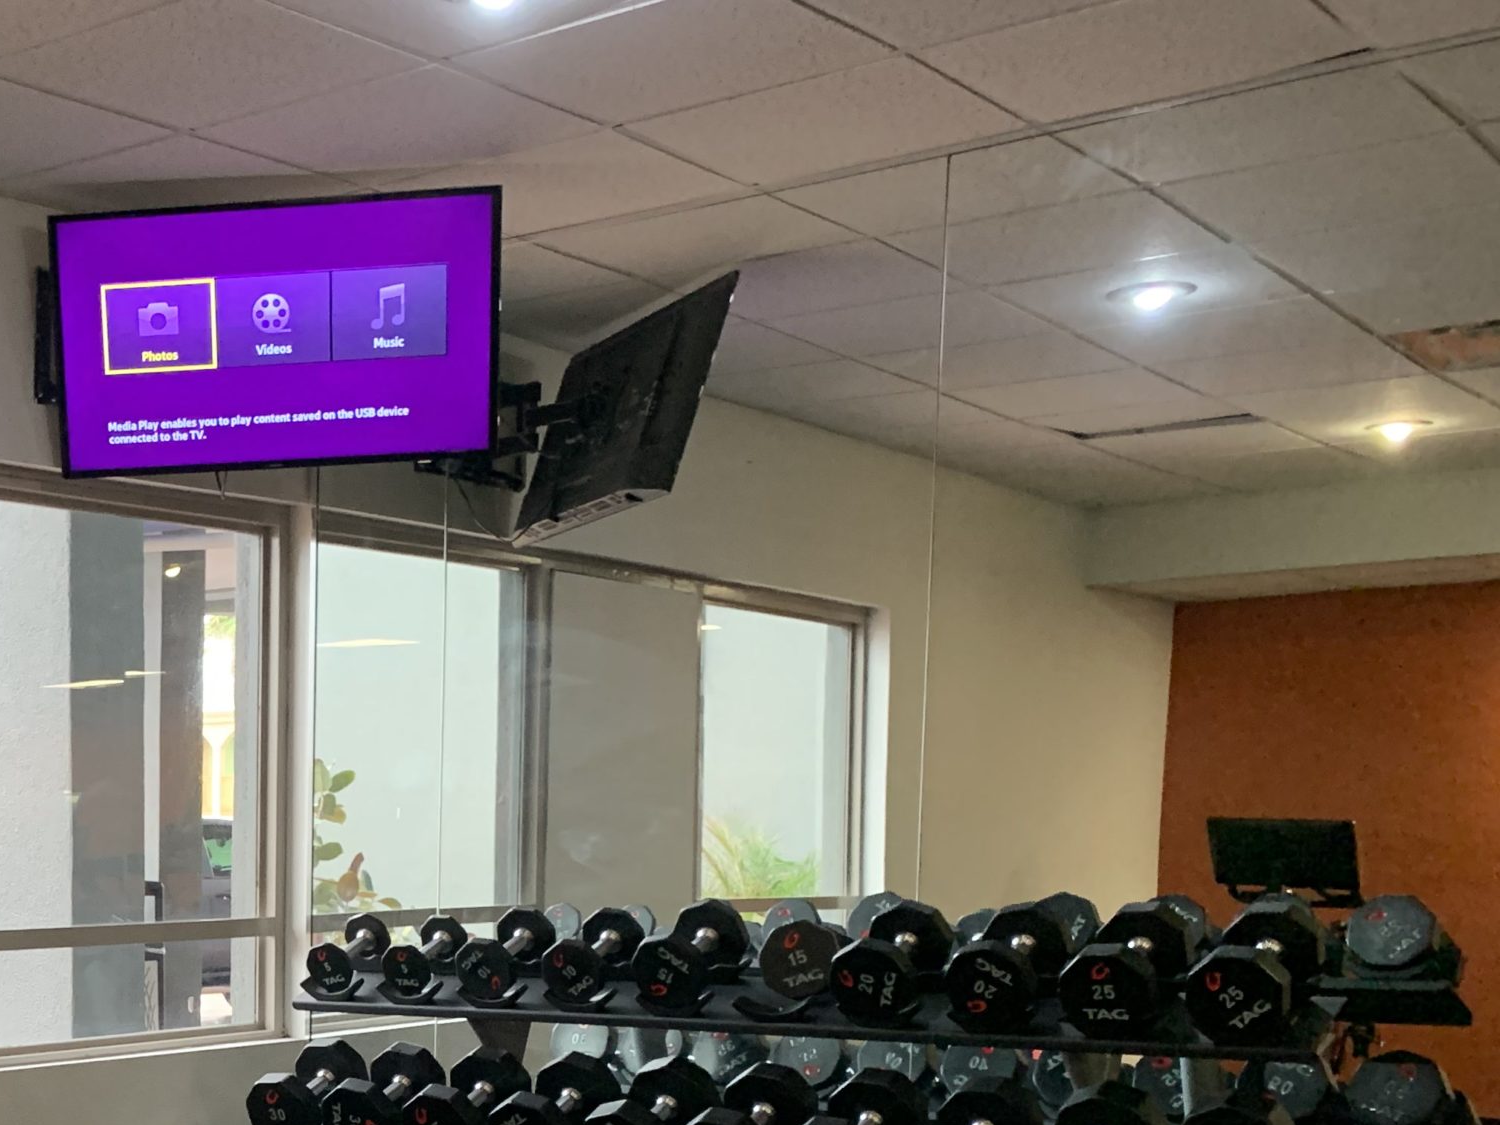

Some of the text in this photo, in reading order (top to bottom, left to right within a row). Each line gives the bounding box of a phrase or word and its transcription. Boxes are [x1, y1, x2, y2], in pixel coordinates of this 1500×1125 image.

[255, 343, 292, 356] Videos
[373, 336, 405, 349] Music
[141, 350, 179, 362] Photos
[108, 405, 410, 432] Media Play enables you to play content saved on the USB device
[109, 429, 207, 445] connected to the TV.
[323, 961, 331, 972] 5
[657, 947, 692, 975] TAG
[788, 949, 808, 967] 15
[400, 963, 408, 973] 5
[477, 965, 491, 979] 10
[562, 965, 577, 980] 10
[657, 967, 674, 984] 15
[975, 957, 1014, 988] TAG
[322, 973, 345, 987] TAG
[395, 977, 419, 988] TAG
[567, 976, 594, 997] TAG
[783, 968, 825, 988] TAG
[858, 973, 875, 994] 20
[879, 971, 897, 1008] TAG
[973, 979, 998, 1000] 20
[1091, 984, 1116, 1001] 25
[1218, 984, 1245, 1010] 25
[1081, 1007, 1131, 1021] TAG
[1227, 999, 1273, 1030] TAG
[268, 1107, 287, 1121] 30
